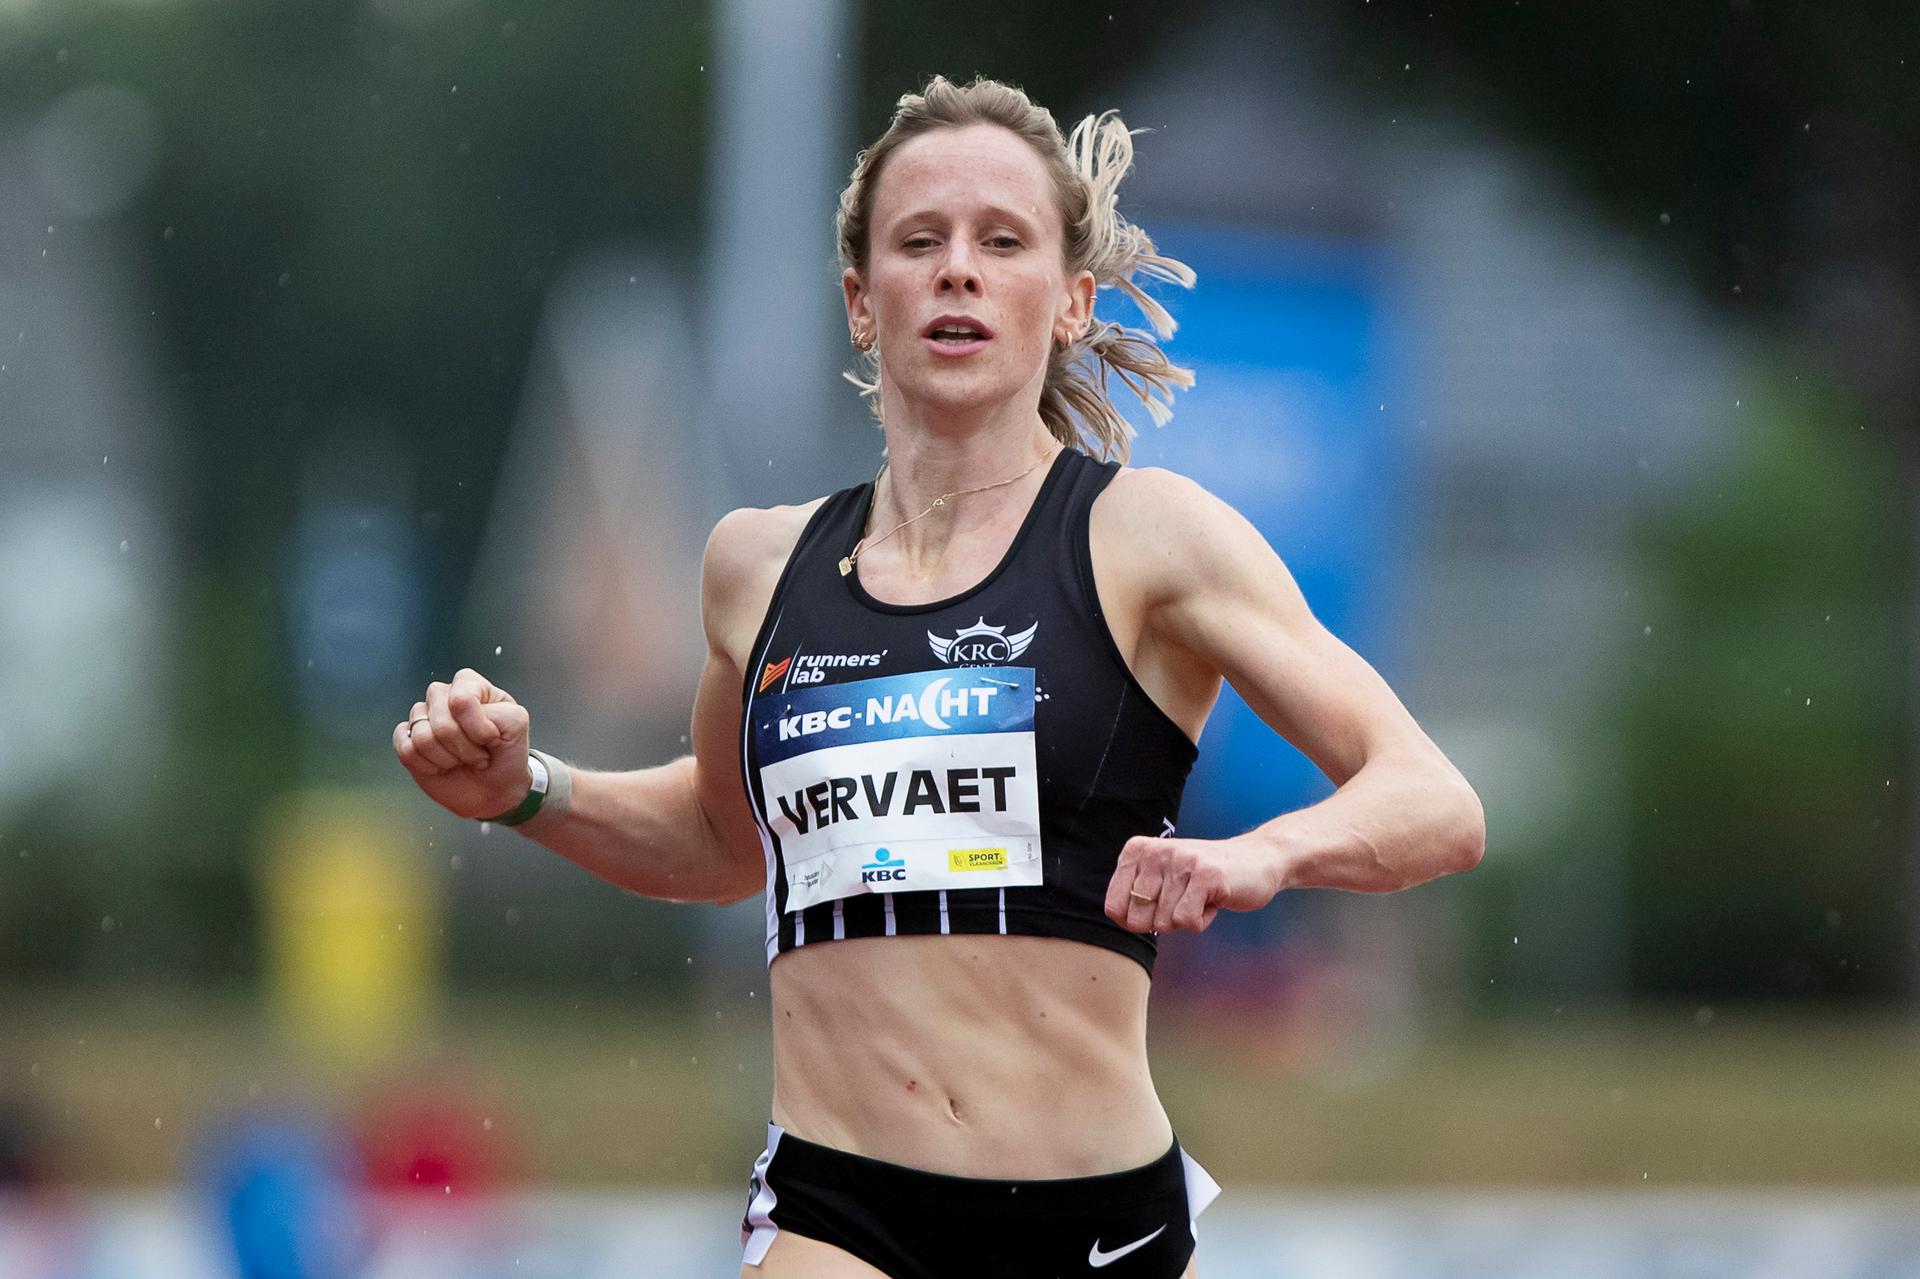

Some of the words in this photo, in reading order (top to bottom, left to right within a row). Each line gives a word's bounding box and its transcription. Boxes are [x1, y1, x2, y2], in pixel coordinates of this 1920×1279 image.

[953, 642, 1006, 662] KRC
[791, 667, 825, 685] lab
[777, 766, 1016, 836] VERVAET
[861, 868, 906, 883] KBC
